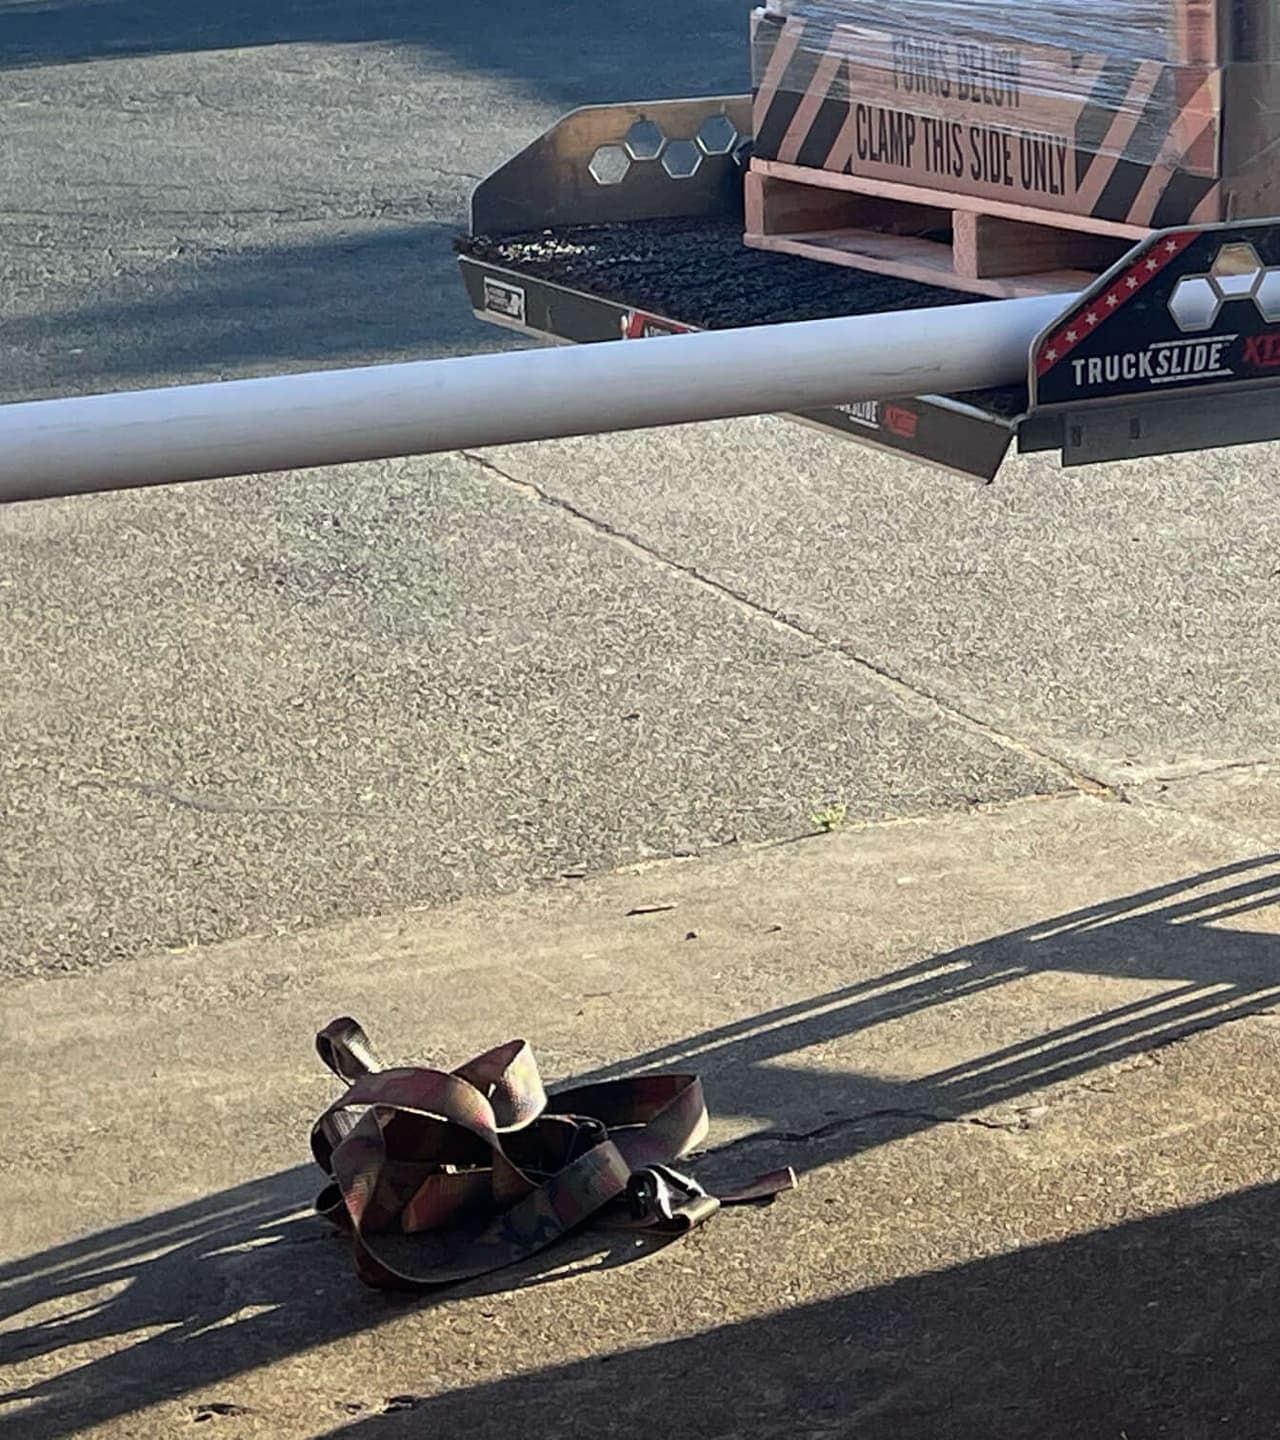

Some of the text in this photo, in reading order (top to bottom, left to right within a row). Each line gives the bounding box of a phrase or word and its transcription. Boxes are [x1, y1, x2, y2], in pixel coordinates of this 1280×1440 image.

[856, 103, 1069, 196] CLAMP THIS SIDE ONLY
[1071, 341, 1225, 387] TRUCKSLIDE
